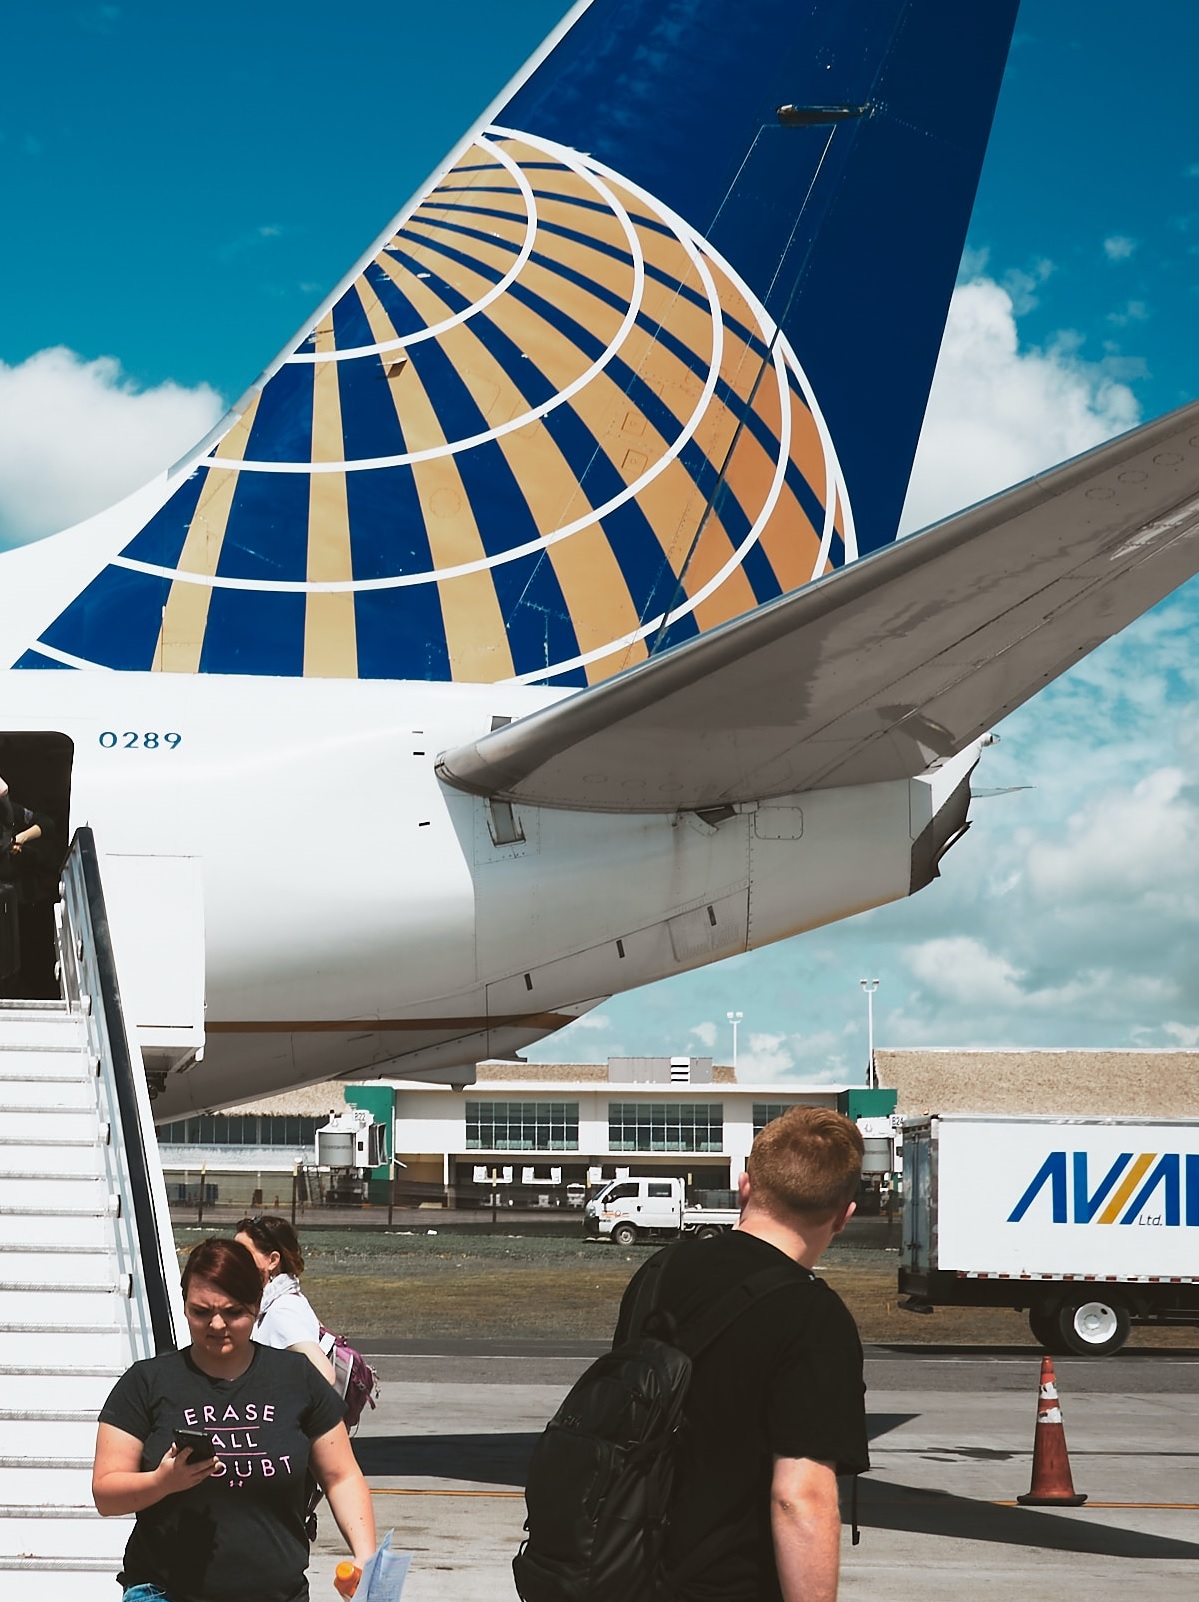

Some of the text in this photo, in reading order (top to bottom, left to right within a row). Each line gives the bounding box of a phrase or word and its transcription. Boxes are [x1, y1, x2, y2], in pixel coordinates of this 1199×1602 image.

[99, 731, 182, 750] 0289
[1138, 1214, 1163, 1226] Ltd.
[184, 1404, 275, 1426] ERASE
[211, 1433, 258, 1449] ALL
[209, 1456, 291, 1478] OUBT
